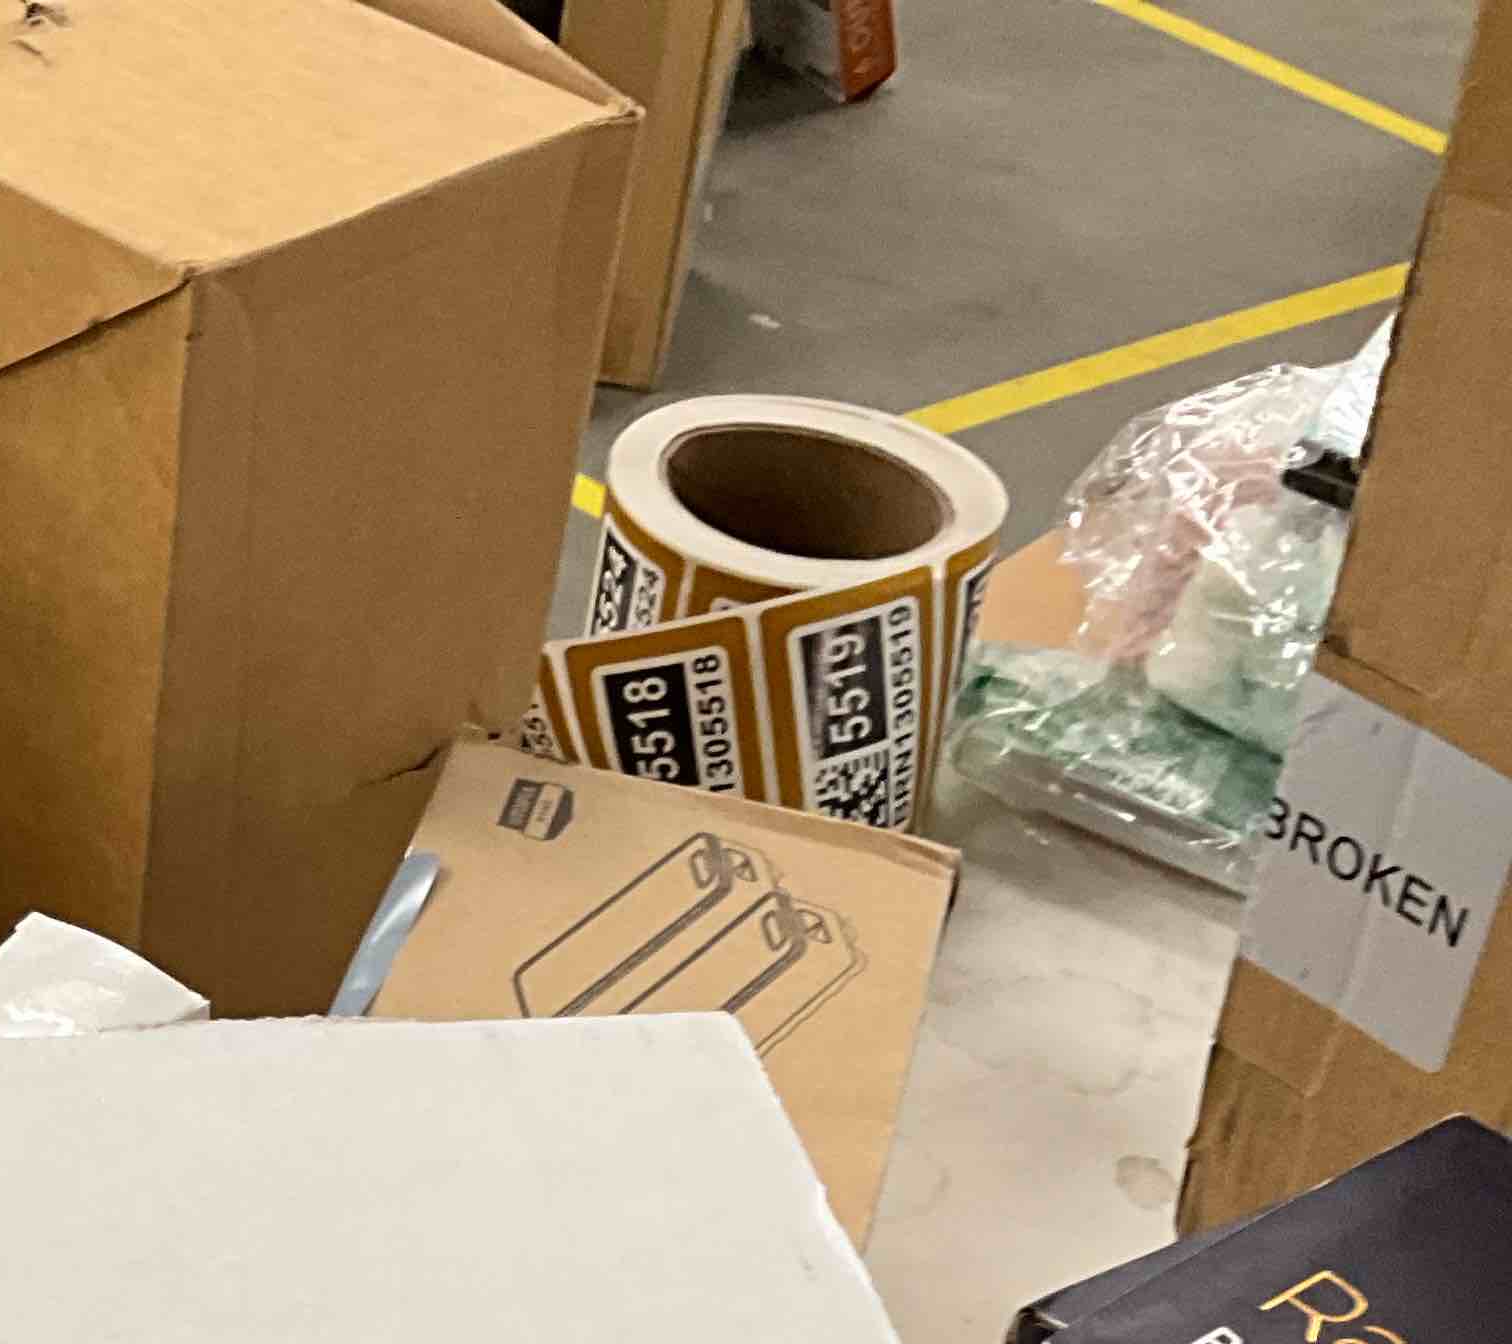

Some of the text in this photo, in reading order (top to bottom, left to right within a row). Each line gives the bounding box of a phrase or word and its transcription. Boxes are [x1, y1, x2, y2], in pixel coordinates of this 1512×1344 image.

[622, 675, 681, 781] 5518
[691, 652, 736, 793] 1305518
[827, 621, 872, 744] 5519
[1264, 796, 1470, 948] BROKEN
